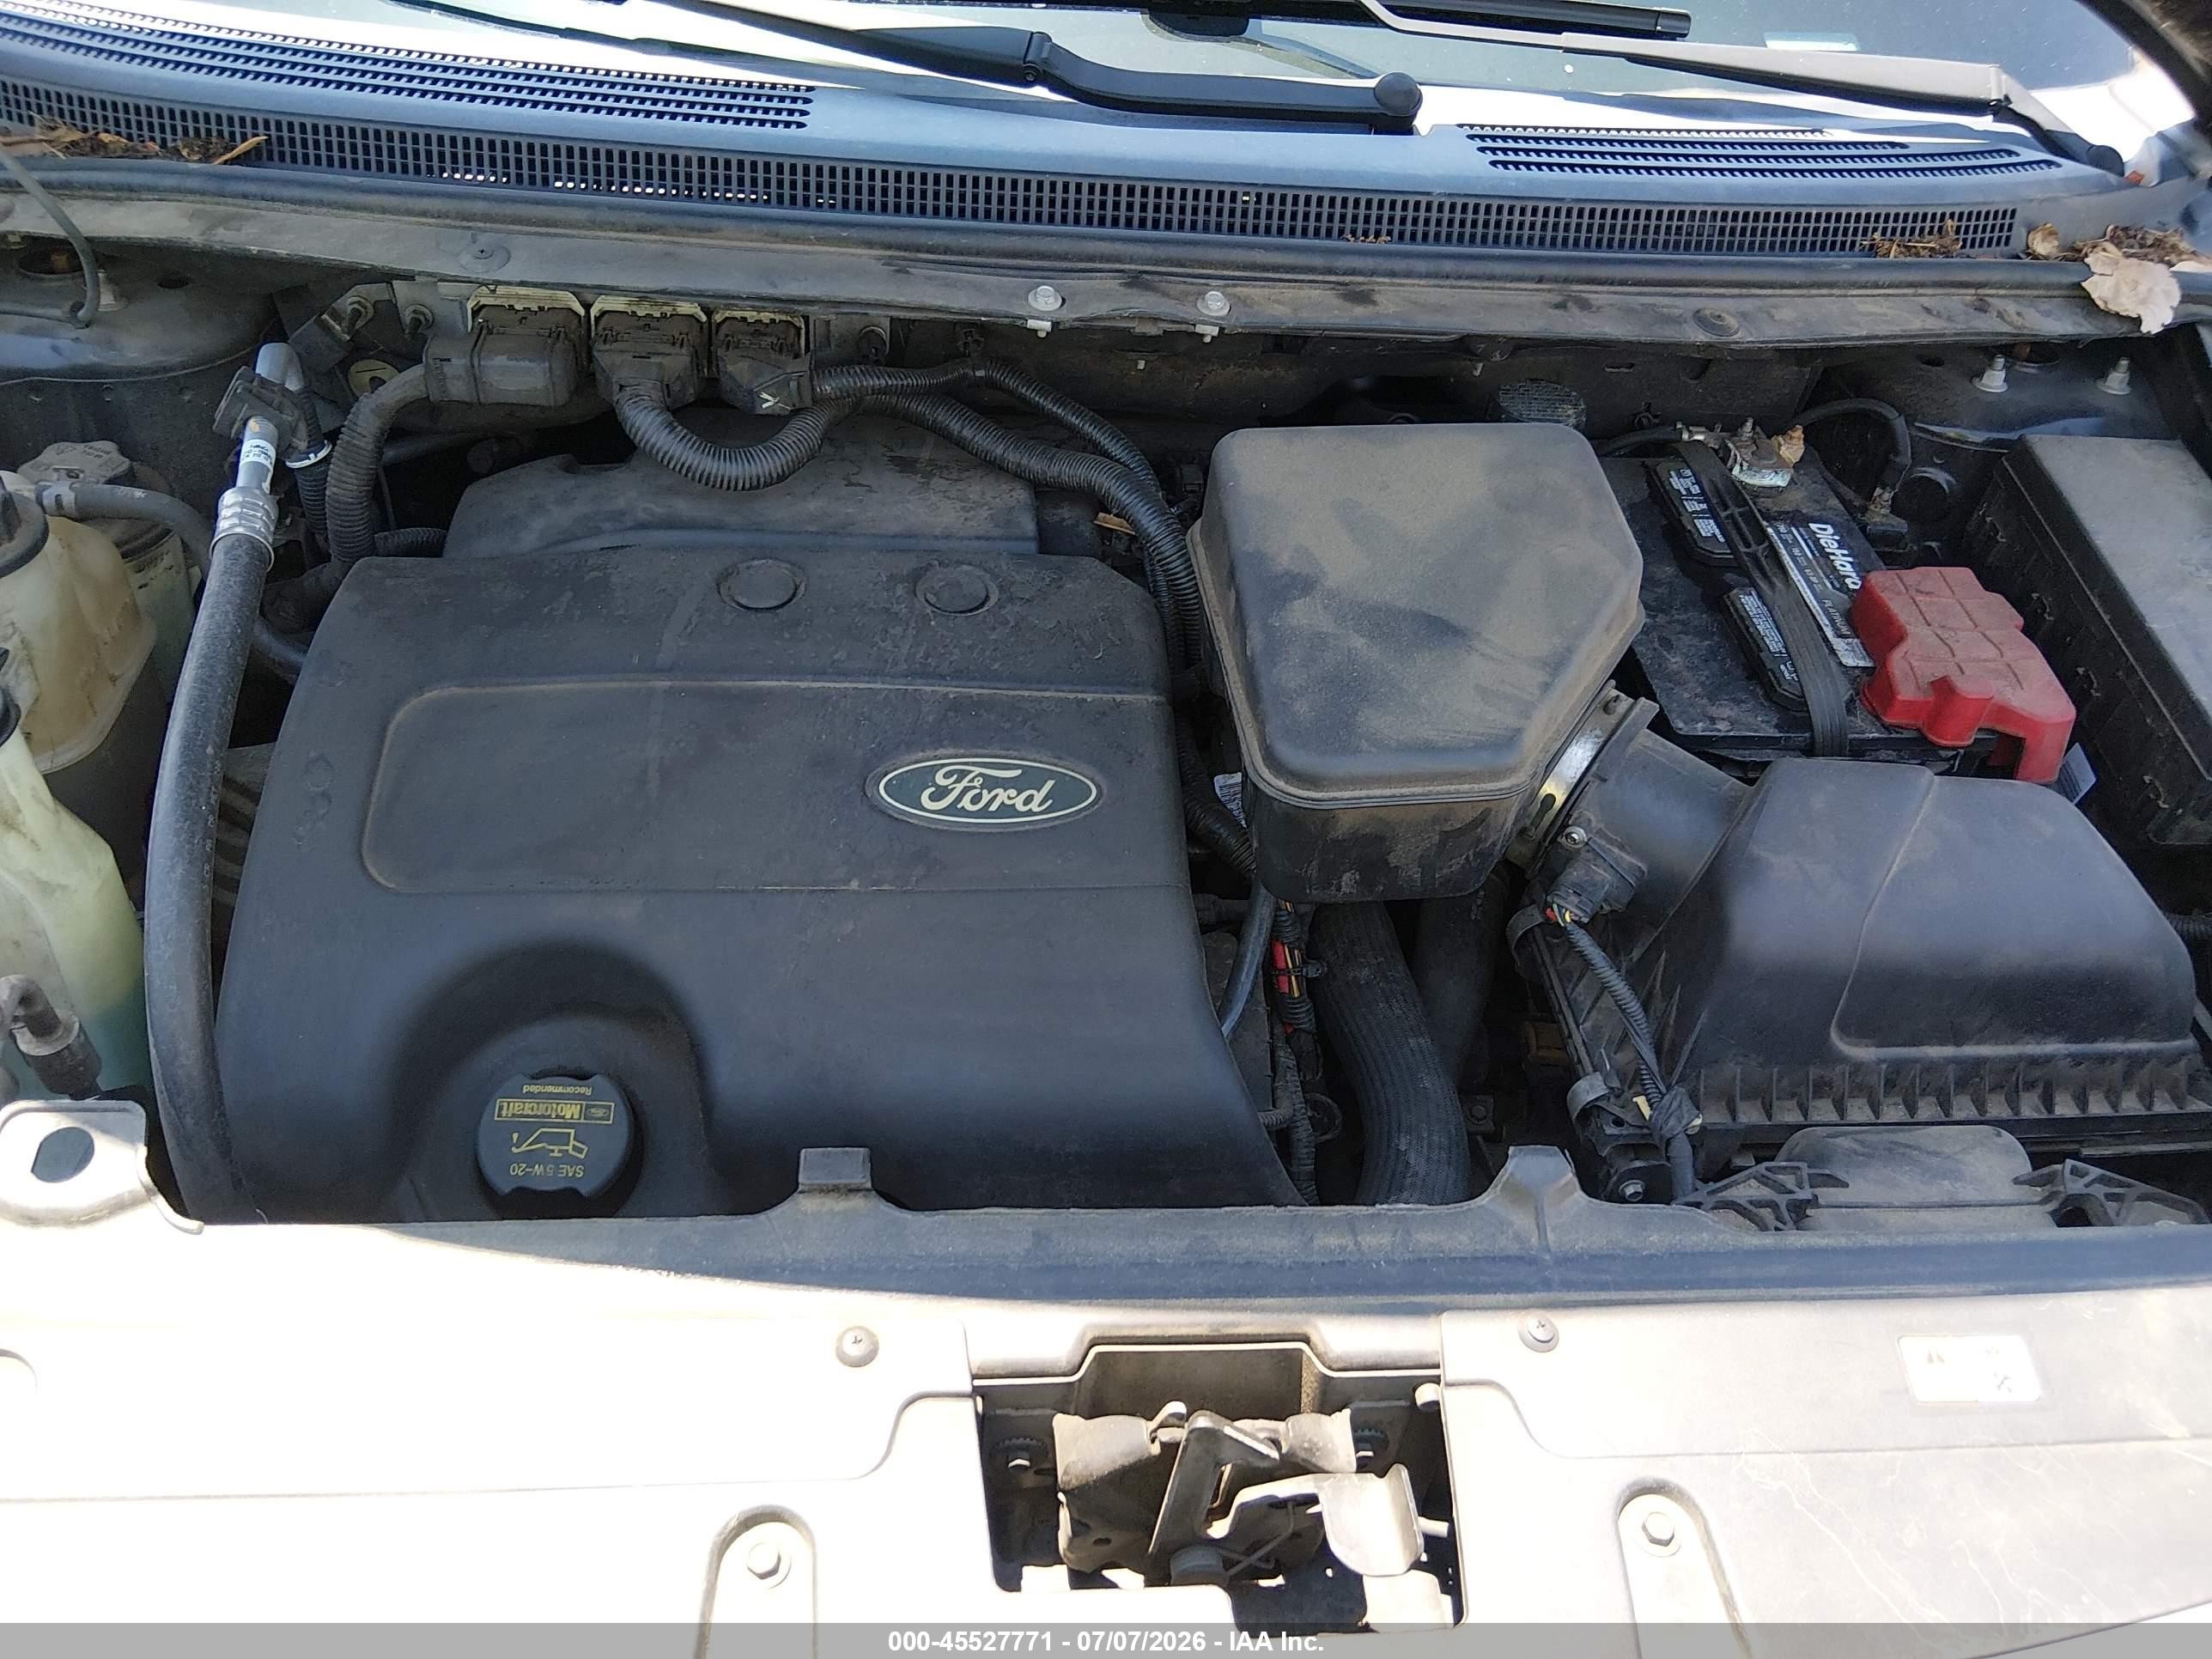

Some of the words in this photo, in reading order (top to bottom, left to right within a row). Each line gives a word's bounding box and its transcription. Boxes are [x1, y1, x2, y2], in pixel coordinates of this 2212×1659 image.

[1822, 599, 1851, 635] PLATINUM
[921, 765, 1056, 812] Ford
[522, 1085, 592, 1096] Recommended
[501, 1102, 581, 1119] Motorcraft
[557, 1164, 585, 1178] SAE
